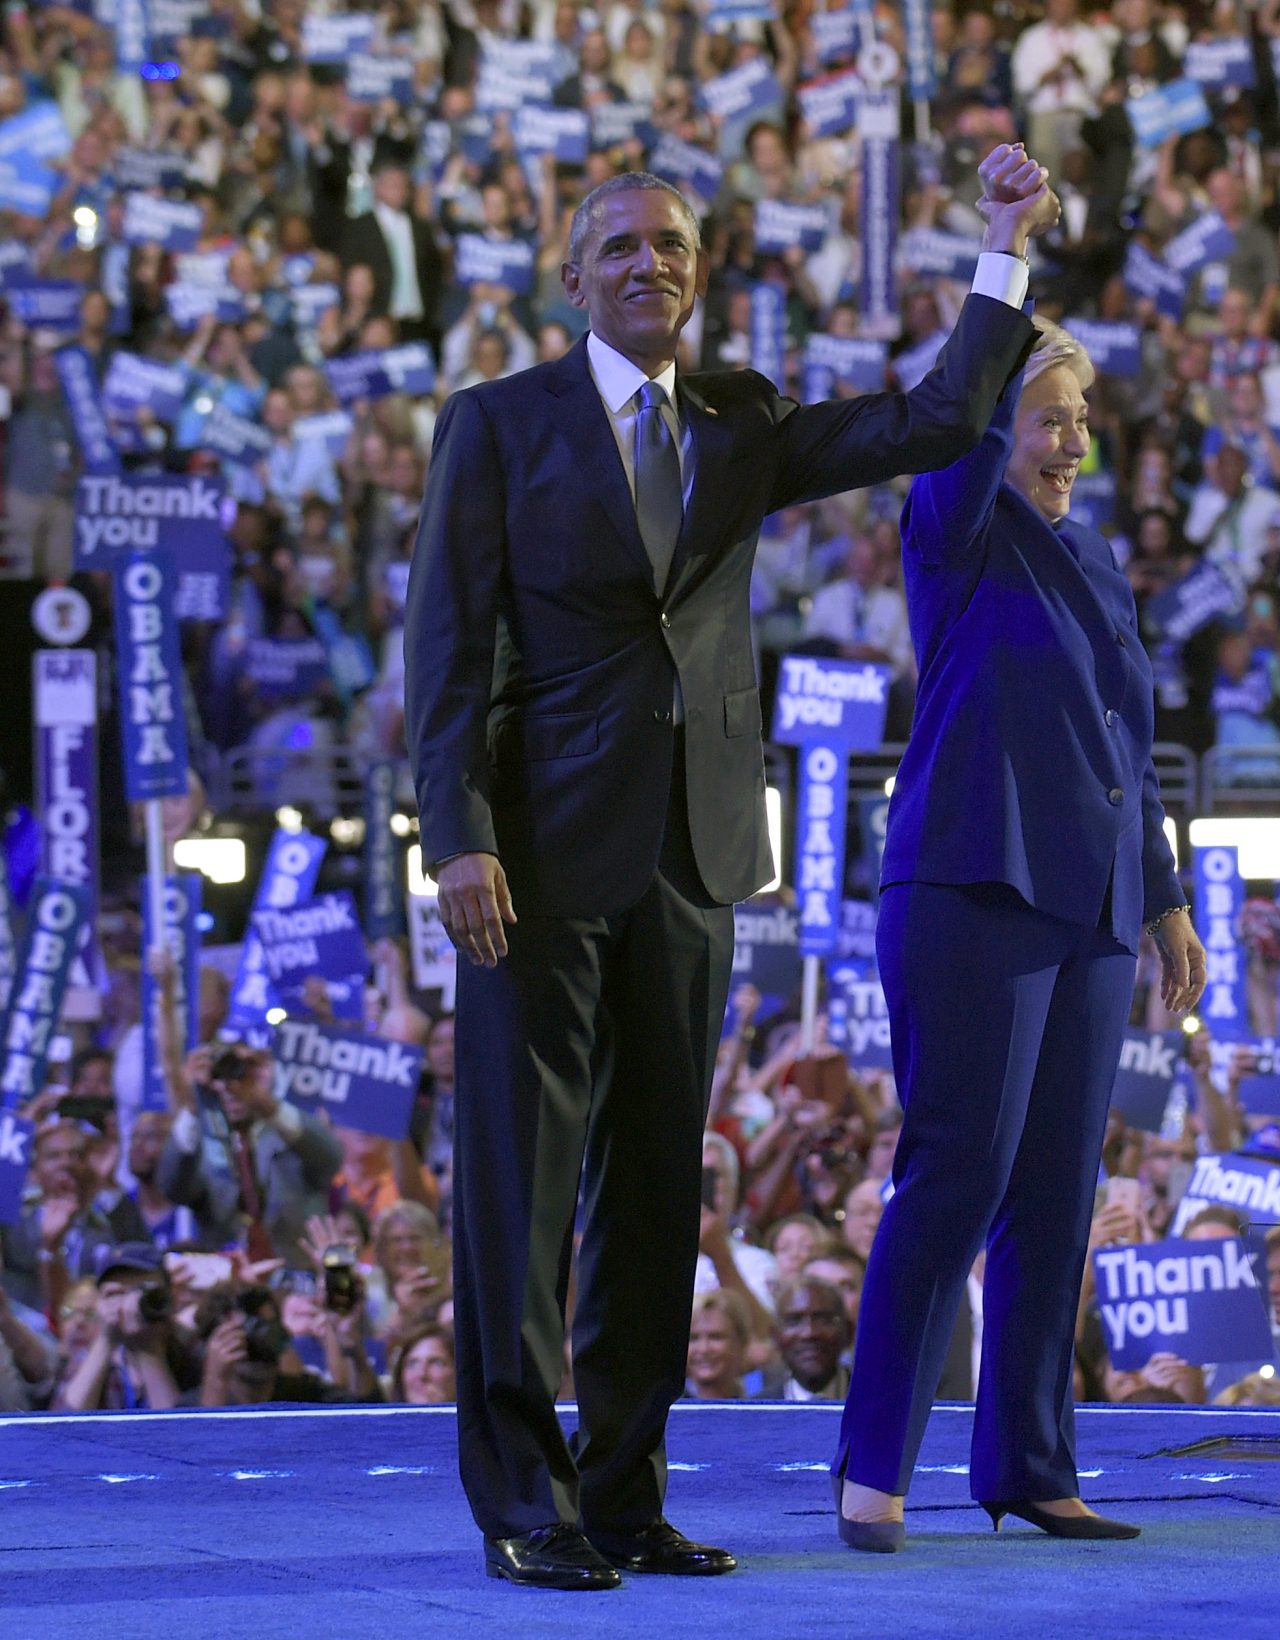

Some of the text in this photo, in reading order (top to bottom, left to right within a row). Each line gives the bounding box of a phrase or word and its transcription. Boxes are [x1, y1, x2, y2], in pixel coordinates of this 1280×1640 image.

[79, 475, 220, 520] Thank
[77, 515, 160, 555] you
[124, 562, 174, 765] OBAMA
[782, 660, 886, 702] Thank
[779, 693, 843, 730] you
[802, 746, 839, 927] OBAMA
[254, 894, 355, 943] Thank
[1202, 848, 1240, 1020] OBAMA
[265, 937, 320, 980] you
[3, 891, 78, 1095] OBAMA
[272, 1058, 350, 1103] you
[279, 1021, 418, 1088] Thank
[1097, 1241, 1262, 1300] Thank
[1100, 1297, 1189, 1352] you
